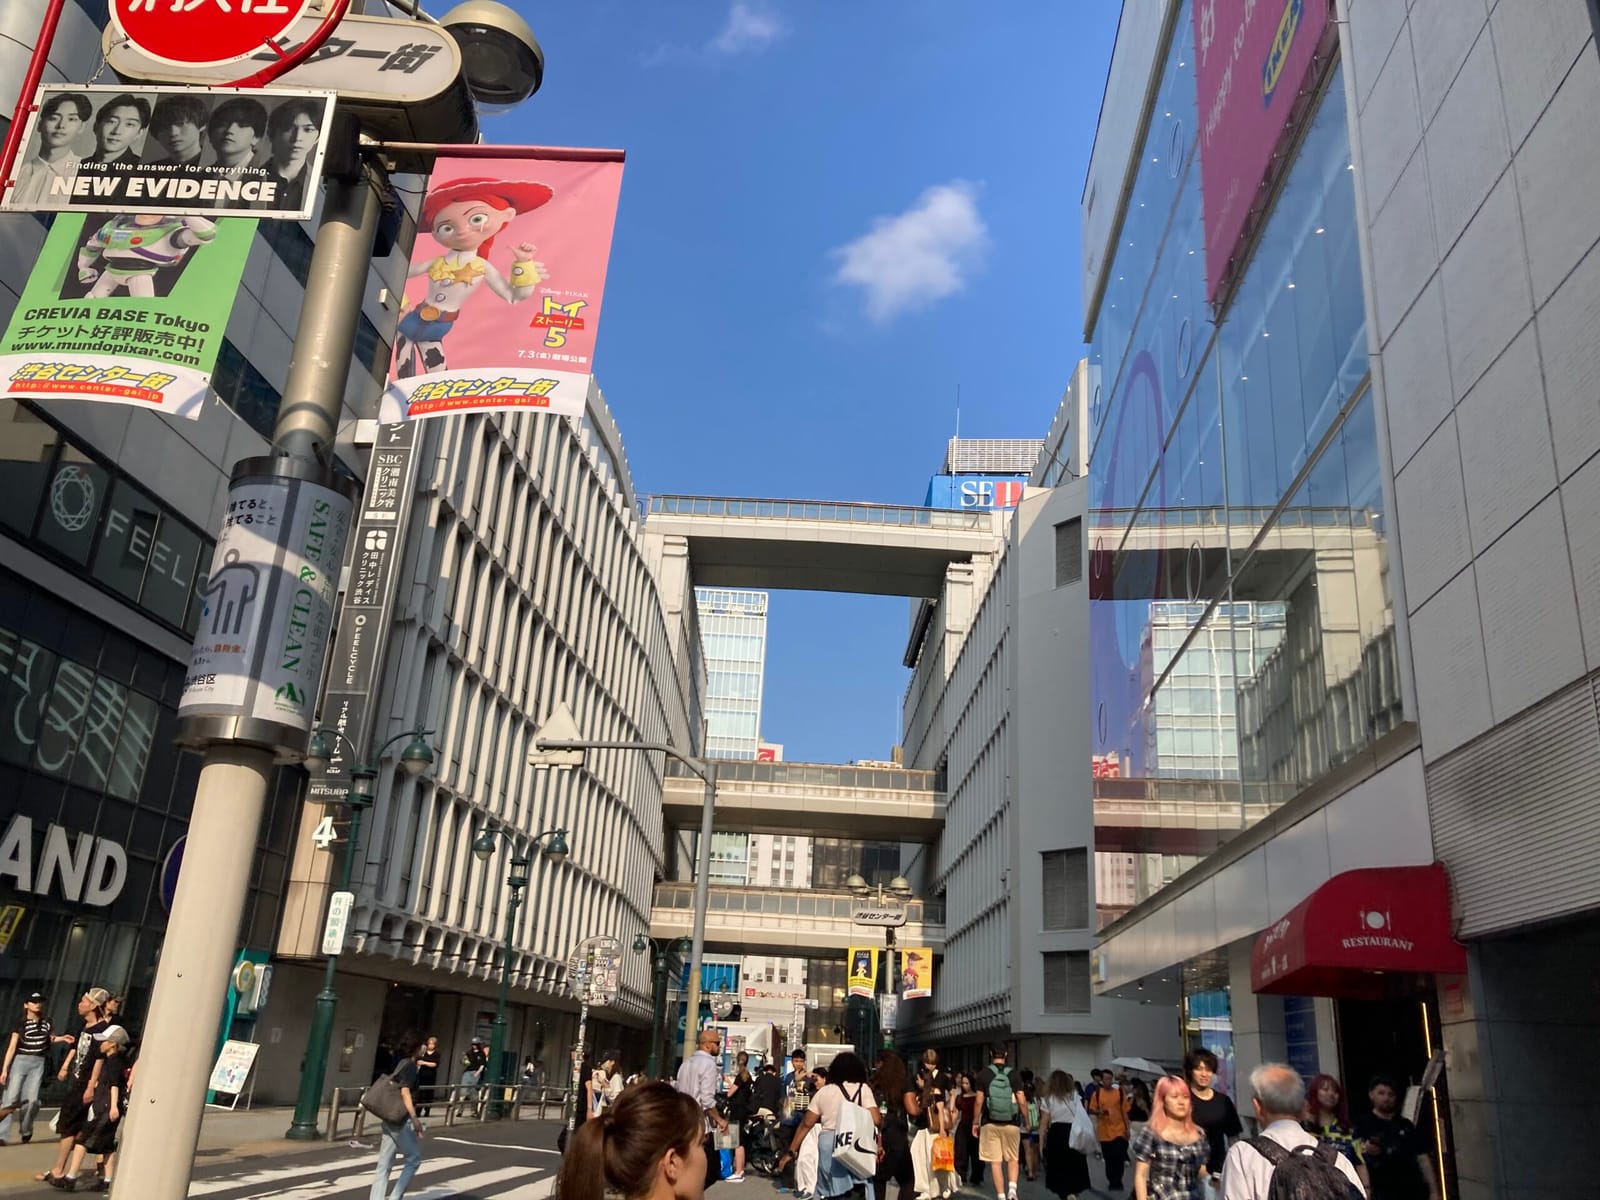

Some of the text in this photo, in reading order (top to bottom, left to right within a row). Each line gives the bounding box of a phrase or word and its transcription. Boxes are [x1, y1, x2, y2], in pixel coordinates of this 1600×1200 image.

[66, 161, 108, 172] Finding
[185, 164, 202, 173] for
[205, 165, 270, 176] everything.
[50, 176, 277, 202] NEW EVIDENCE
[24, 307, 210, 333] CREVIA BASE Tokyo
[543, 296, 588, 318] トイ
[536, 316, 583, 328] ストーリー
[543, 326, 567, 348] 5
[11, 340, 200, 366] www.mundopixar.com
[9, 362, 177, 390] 渋谷センター街
[407, 377, 560, 404] 渋谷センター街
[377, 455, 403, 464] SBC
[376, 467, 390, 508] クリニック
[304, 499, 330, 561] SAFE
[300, 565, 317, 583] &
[353, 551, 369, 604] クリニック渋谷
[362, 551, 378, 604] 田中レディス
[281, 589, 313, 673] CLEAN
[346, 626, 363, 685] FEELCYCLE
[312, 816, 337, 848] 4
[1342, 936, 1414, 951] RESTAURANT
